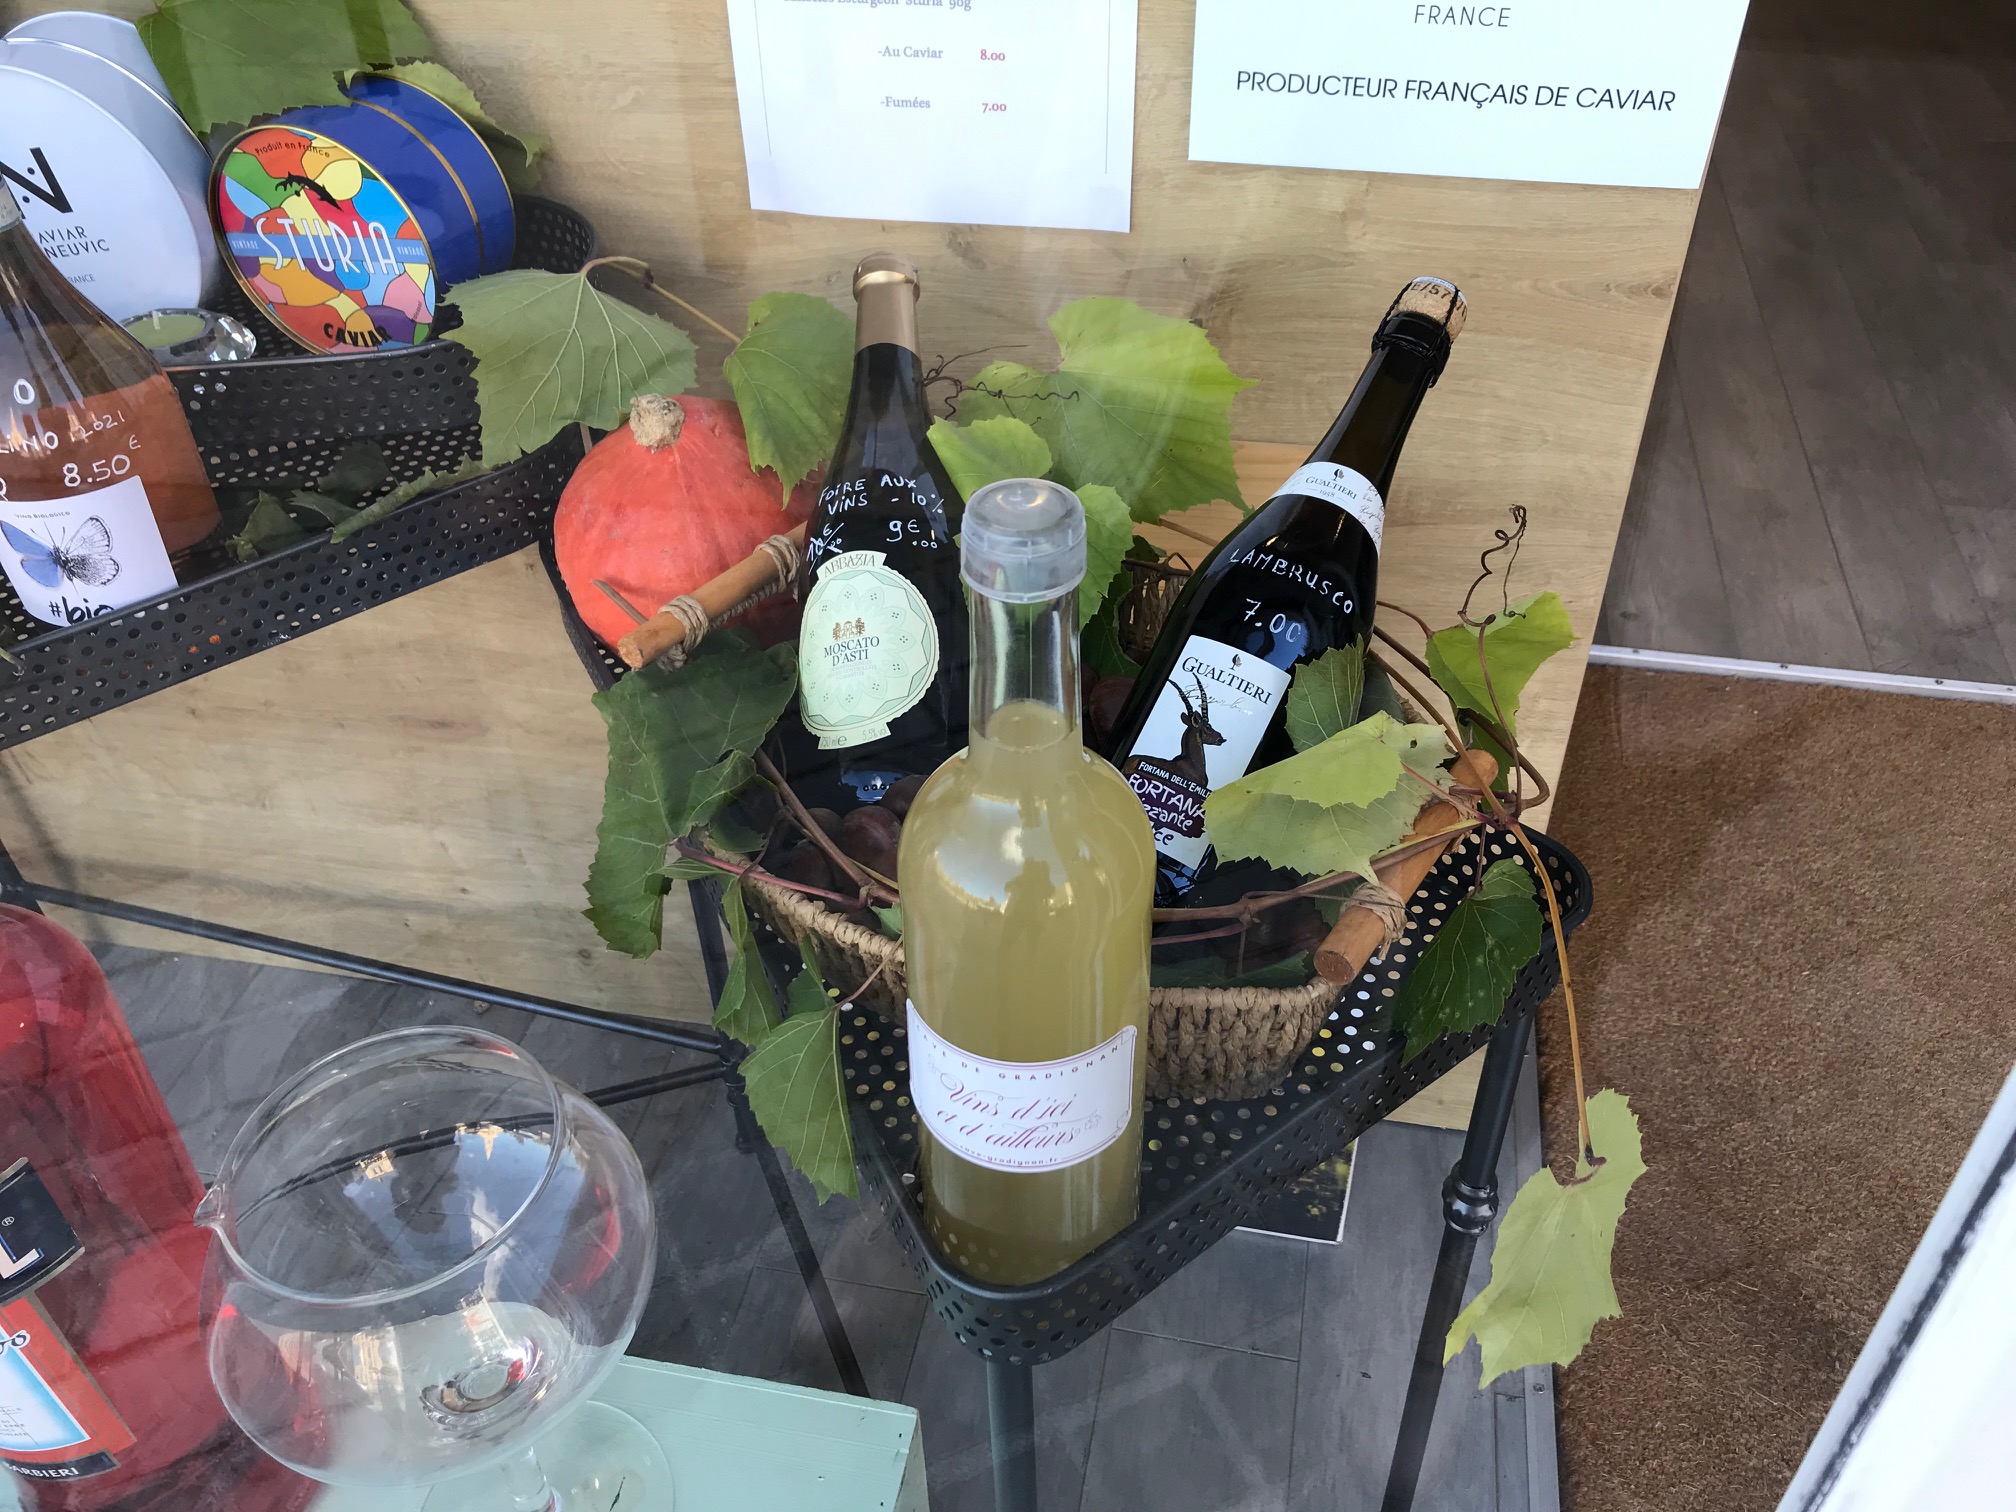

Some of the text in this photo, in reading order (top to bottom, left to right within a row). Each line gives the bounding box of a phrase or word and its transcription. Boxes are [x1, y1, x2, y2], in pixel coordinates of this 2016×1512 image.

[1413, 4, 1511, 28] FRANCE
[903, 46, 944, 59] Caviar
[980, 49, 1006, 61] 8.00
[1236, 70, 1677, 112] PRODUCTEUR FRANÇAIS DE CAVIAR
[982, 102, 1007, 113] 7.00
[255, 141, 330, 159] Produit en France
[38, 225, 88, 245] AVIAR
[231, 239, 260, 250] VINTAGE
[255, 216, 400, 276] STURIA
[397, 245, 425, 257] VINTAGE
[323, 322, 392, 348] CAVIAR
[880, 473, 917, 489] AUX
[1305, 476, 1358, 500] GUALTIERI
[824, 553, 876, 578] ABBAZIA
[1230, 548, 1354, 614] LAMBRUSCO
[824, 635, 880, 659] MOSCATO
[832, 648, 869, 667] D'ASTI
[1181, 656, 1273, 705] GUALTIERI
[1138, 761, 1211, 798] FORTANA DELL'EMILI
[961, 1061, 980, 1073] DE
[998, 1045, 1118, 1081] GRADIGNAN
